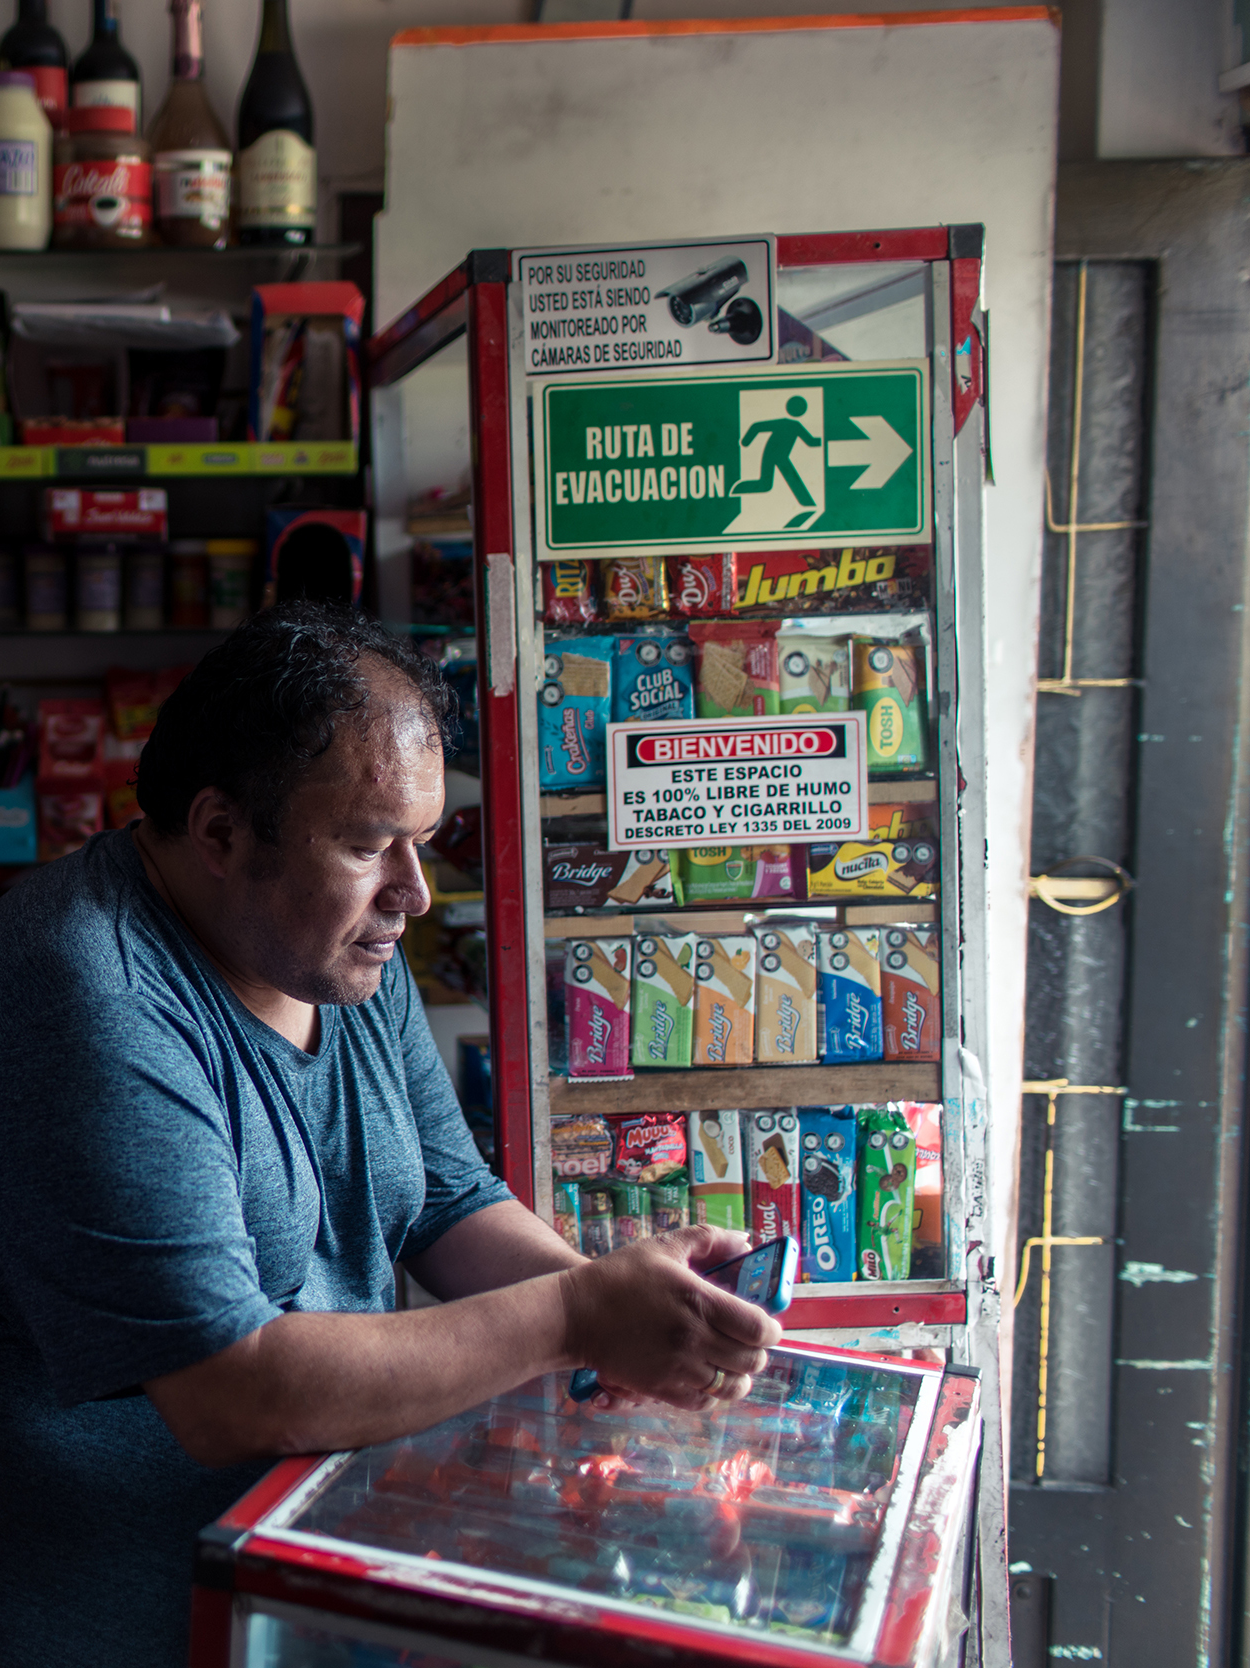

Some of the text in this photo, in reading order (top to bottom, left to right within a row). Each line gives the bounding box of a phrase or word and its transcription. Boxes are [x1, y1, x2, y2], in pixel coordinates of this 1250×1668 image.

[528, 259, 646, 285] POR SU SEGURIDAD
[529, 285, 651, 312] USTED ESTÁ SIENDO
[531, 314, 648, 340] MONITOREADO POR
[531, 339, 683, 367] CÁMARAS DE SEGURIDAD
[586, 422, 694, 460] RUTA DE
[555, 464, 725, 506] EVACUACION
[733, 548, 897, 610] Jumbo
[637, 668, 674, 692] CLUB
[879, 704, 893, 750] TOSH
[653, 732, 820, 761] BIENVENIDO
[671, 764, 803, 784] ESTE ESPACIO
[623, 781, 852, 805] ES 100% LIBRE DE HUMO
[633, 800, 843, 823] TABACO Y CIGARRILLO
[625, 817, 852, 839] DESCRETO LEY 1335 DEL 2009
[692, 846, 726, 858] TOSH
[552, 862, 613, 887] Bridge
[586, 1004, 612, 1065] Bridge
[648, 1000, 674, 1061] Bridge
[706, 1003, 732, 1063] Bridge
[775, 993, 801, 1055] Bridge
[845, 992, 870, 1050] Bridge
[900, 991, 926, 1051] Bridge
[552, 1152, 607, 1176] noel
[812, 1197, 837, 1271] OREO
[865, 1252, 877, 1278] MILO
